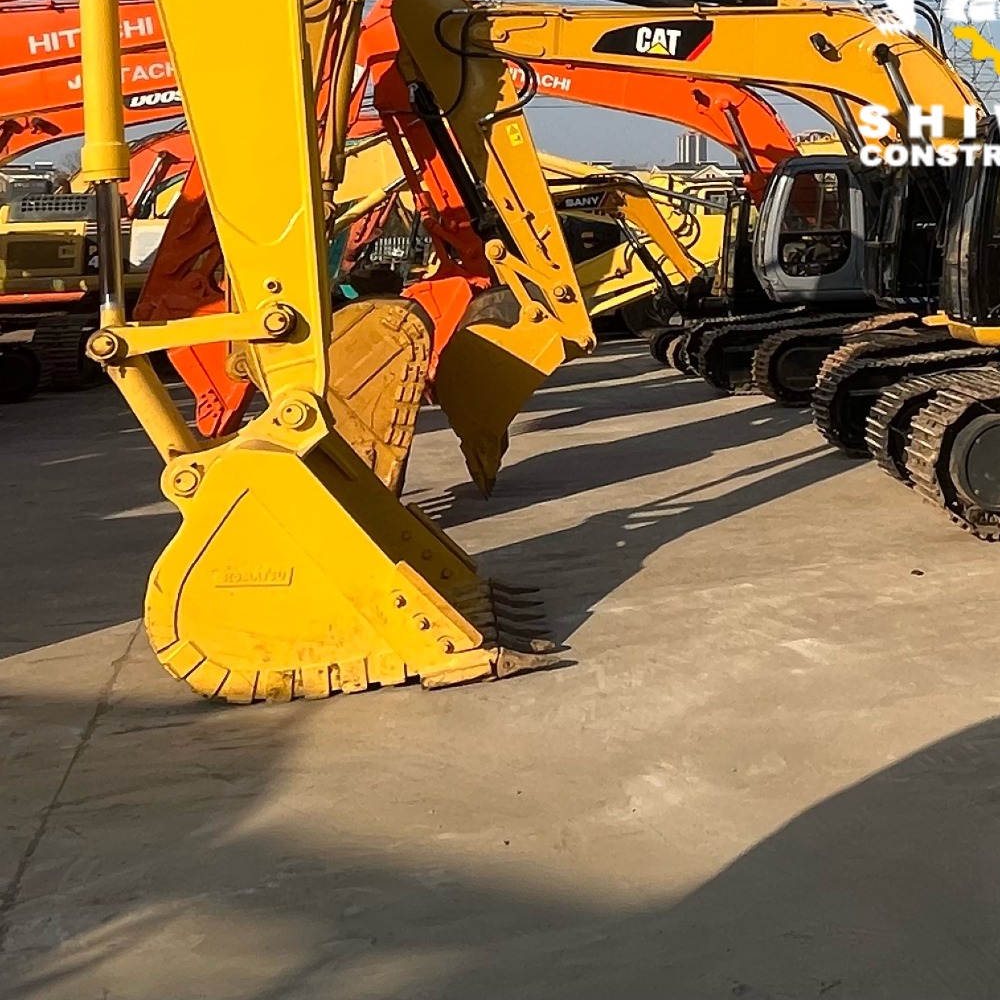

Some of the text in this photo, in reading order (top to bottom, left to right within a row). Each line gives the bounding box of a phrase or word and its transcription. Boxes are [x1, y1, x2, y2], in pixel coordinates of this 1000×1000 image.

[27, 16, 154, 55] HITHI
[635, 26, 682, 56] CAT
[564, 196, 600, 207] SANY
